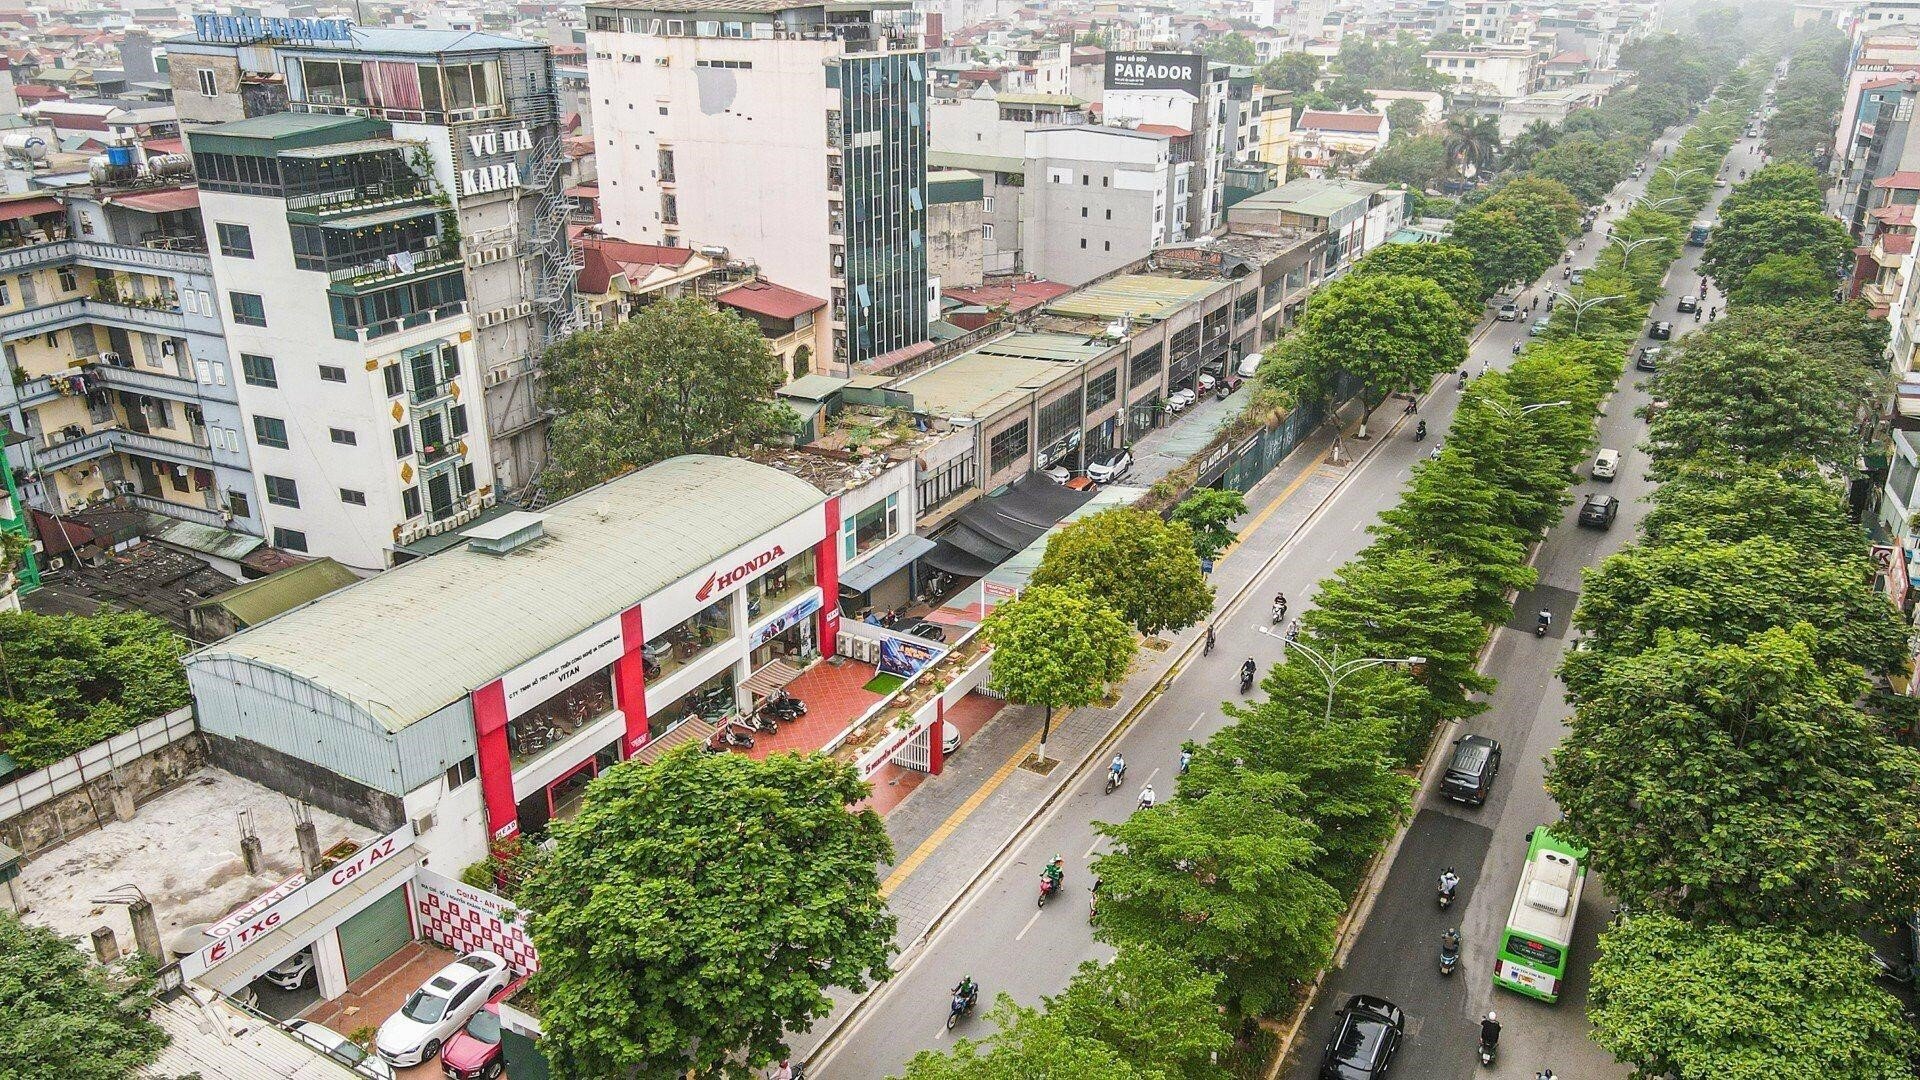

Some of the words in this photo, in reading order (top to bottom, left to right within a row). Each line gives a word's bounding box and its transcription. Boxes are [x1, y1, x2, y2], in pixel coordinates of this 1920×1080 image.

[1114, 63, 1192, 80] PARADOR
[468, 128, 497, 157] VŨ
[461, 162, 520, 195] KARA
[717, 545, 785, 592] HONDA
[558, 666, 580, 682] VITAN
[865, 764, 871, 775] 5
[497, 821, 516, 837] HEAD
[332, 858, 364, 887] Car
[370, 838, 396, 866] AZ
[484, 900, 495, 910] AN
[237, 912, 281, 942] TXG
